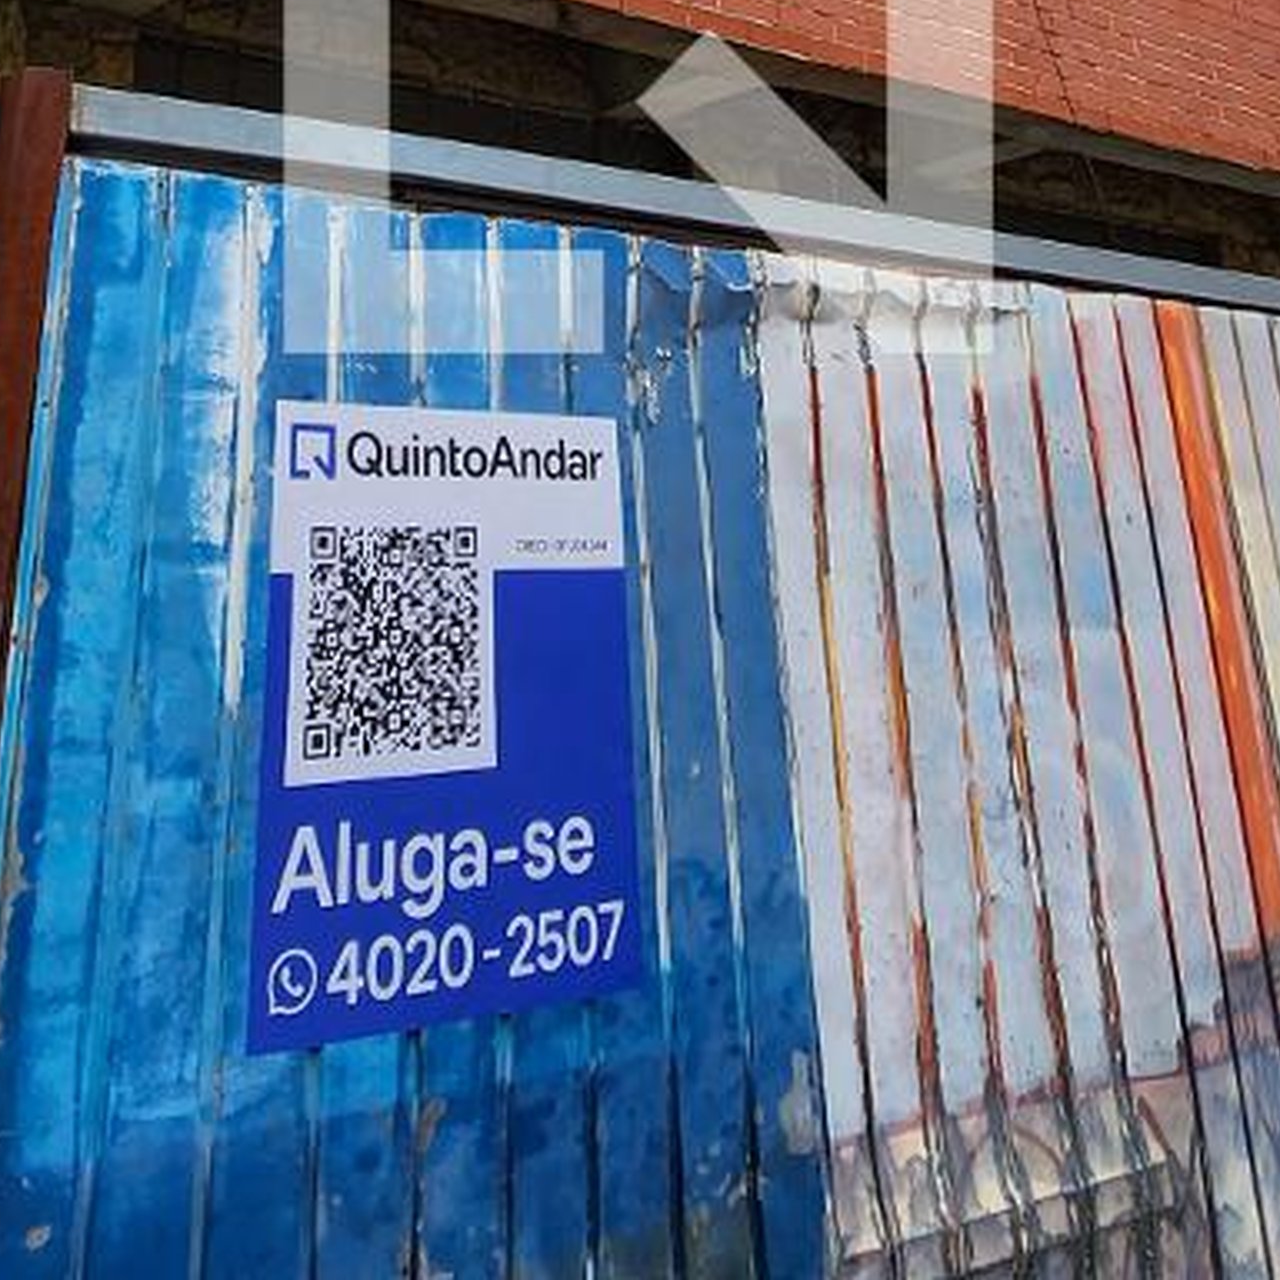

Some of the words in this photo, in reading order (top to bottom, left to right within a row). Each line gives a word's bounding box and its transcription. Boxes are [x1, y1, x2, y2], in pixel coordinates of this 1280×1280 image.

[347, 432, 602, 481] QuintoAndar
[271, 816, 595, 918] Aluga-se
[327, 901, 625, 1004] 4020-2507
